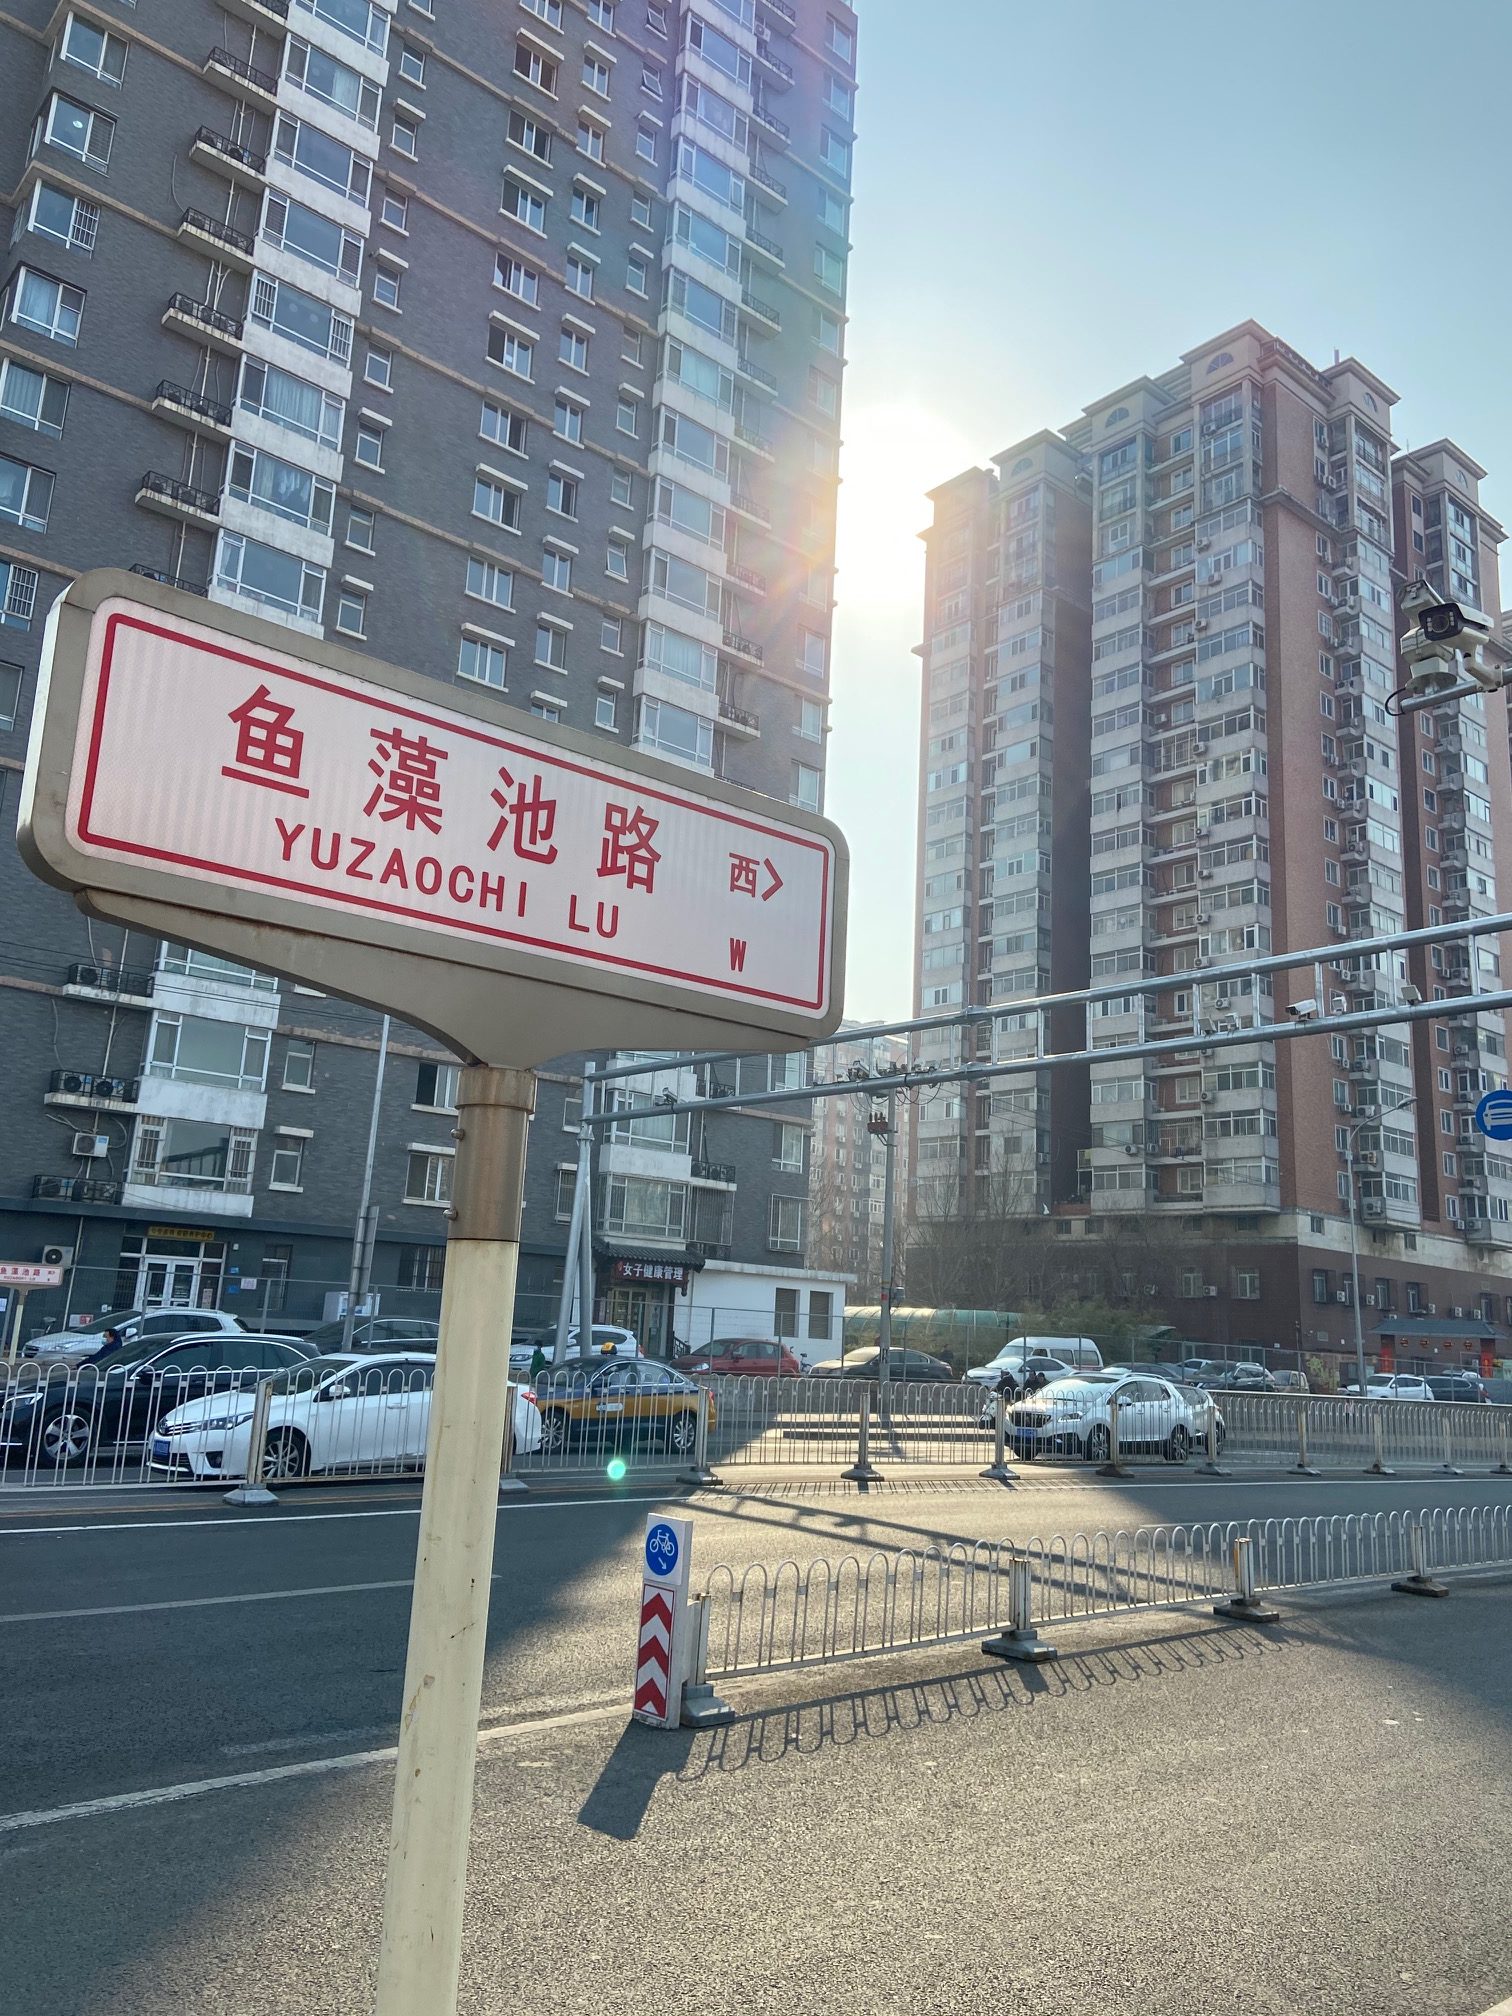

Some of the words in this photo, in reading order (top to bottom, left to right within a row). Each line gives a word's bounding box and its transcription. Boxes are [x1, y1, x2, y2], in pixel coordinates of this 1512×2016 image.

[221, 685, 661, 894] 鱼藻池路
[275, 817, 528, 918] YUZAOCHI
[568, 895, 619, 938] LU
[728, 852, 760, 898] 西
[729, 937, 747, 972] W
[623, 1262, 683, 1280] 女子健康管理
